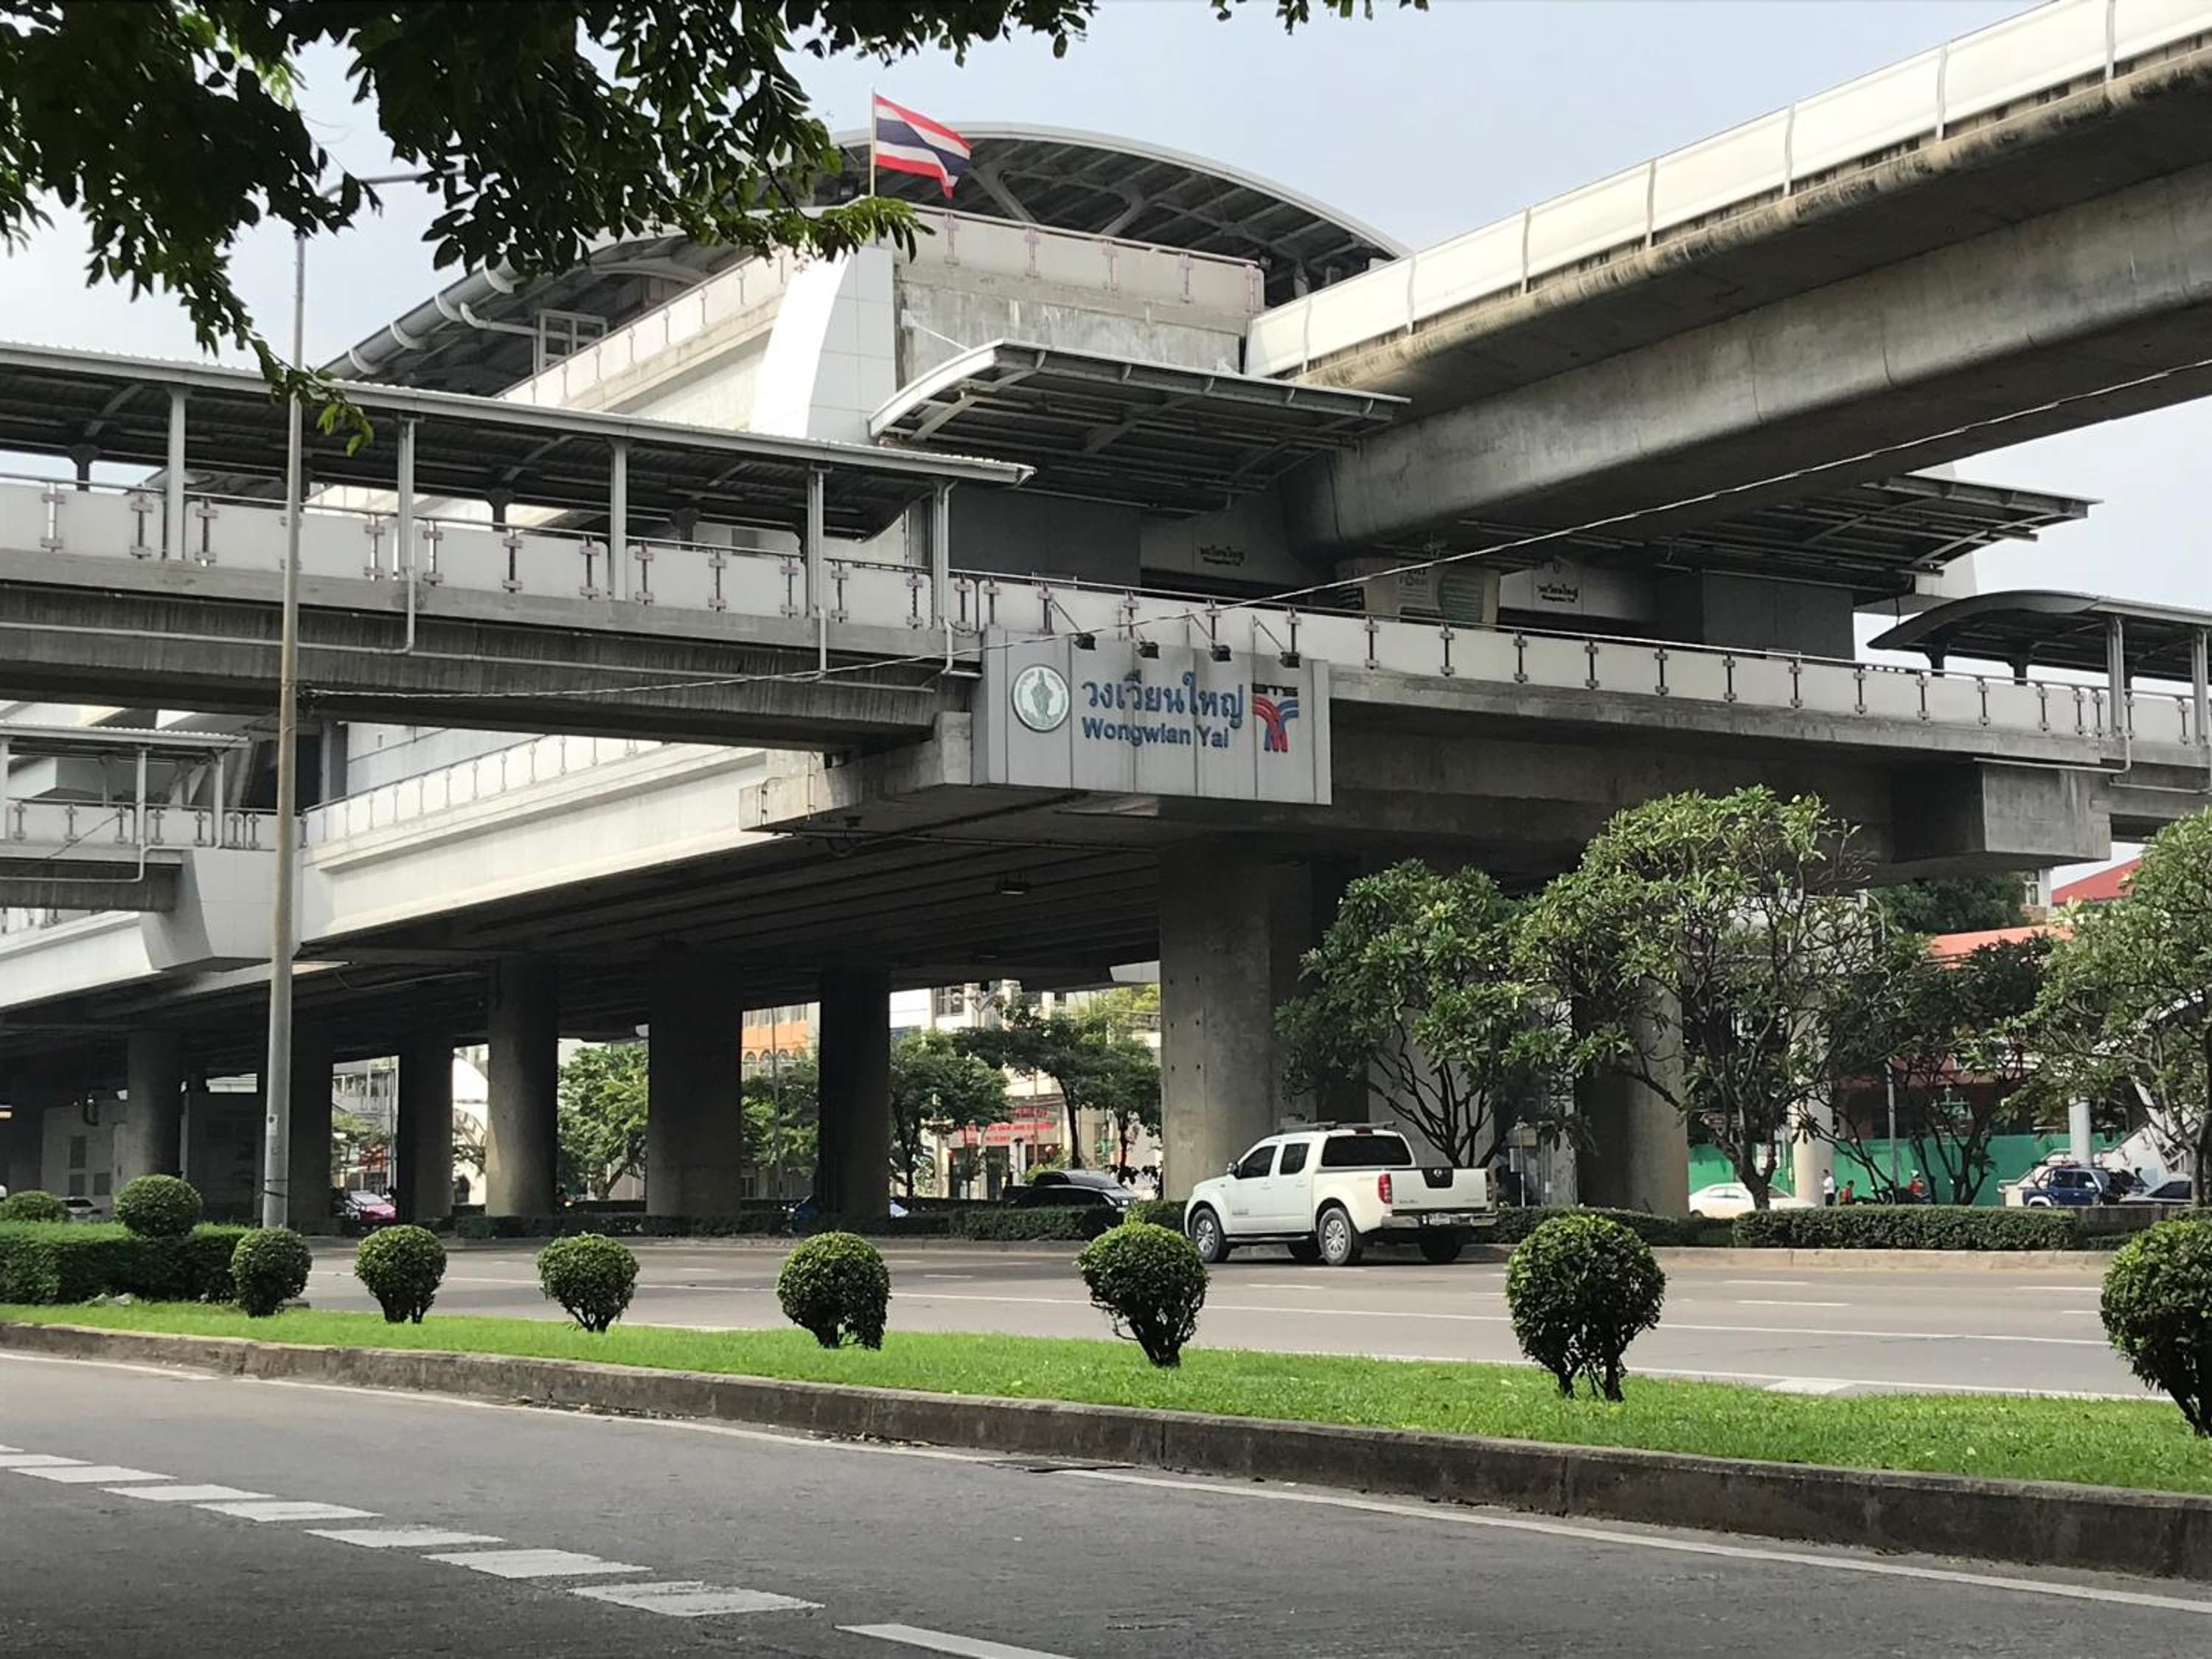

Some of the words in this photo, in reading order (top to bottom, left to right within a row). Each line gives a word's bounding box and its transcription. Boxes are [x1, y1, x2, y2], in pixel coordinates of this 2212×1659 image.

[1082, 669, 1244, 729] วงเวียนใหญ่
[1082, 717, 1192, 747] Wongwian
[1196, 725, 1229, 748] Yai
